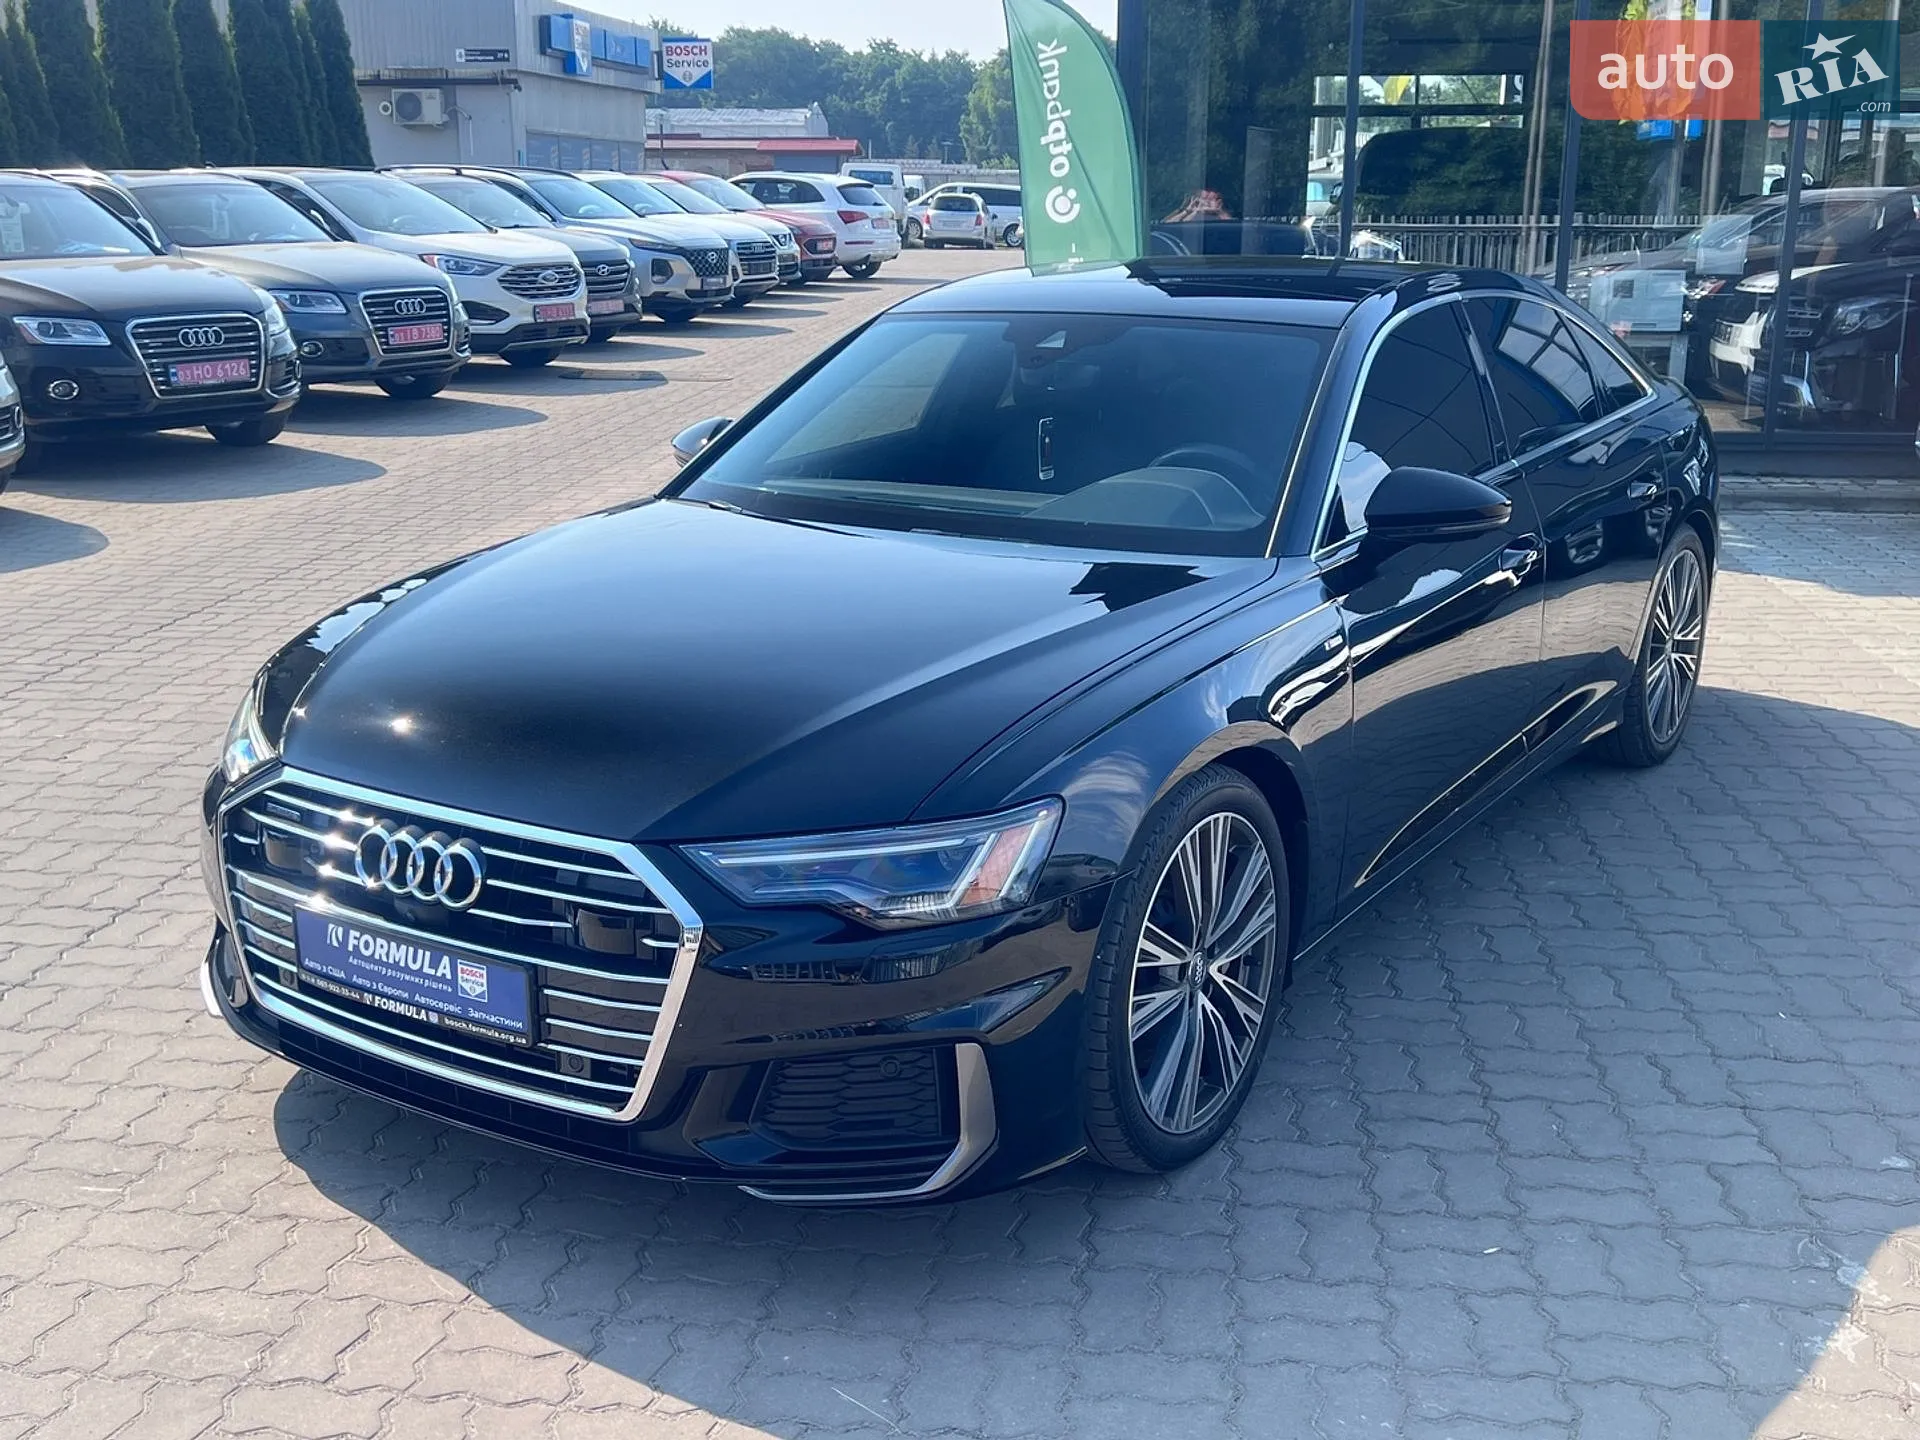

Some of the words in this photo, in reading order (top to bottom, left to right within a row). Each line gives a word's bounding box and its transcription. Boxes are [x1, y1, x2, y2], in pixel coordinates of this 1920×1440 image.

[665, 45, 708, 56] BOSCH
[666, 58, 709, 68] Service
[216, 362, 246, 378] 6126
[347, 929, 452, 979] FORMULA
[460, 966, 484, 979] BOSCH
[327, 966, 346, 979] США
[414, 992, 462, 1014] Автосервіс
[468, 1007, 523, 1030] Запчастини
[374, 995, 427, 1022] FORMULA
